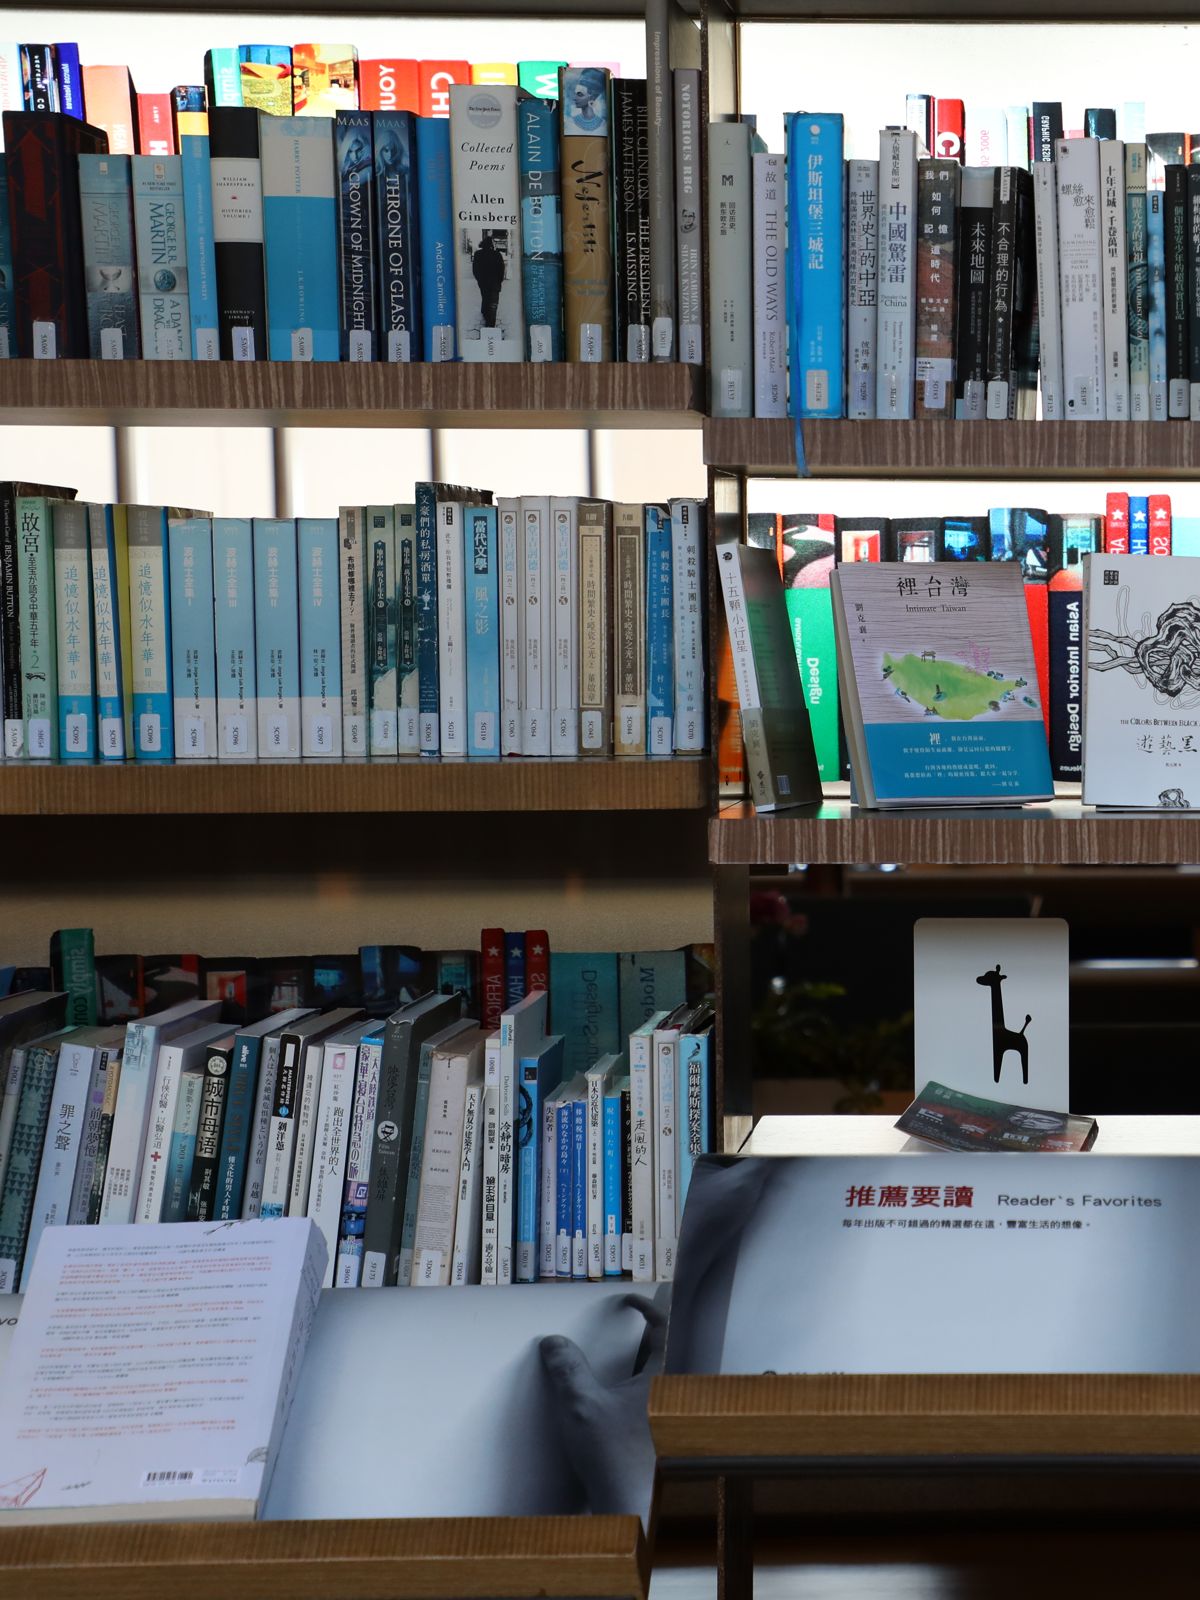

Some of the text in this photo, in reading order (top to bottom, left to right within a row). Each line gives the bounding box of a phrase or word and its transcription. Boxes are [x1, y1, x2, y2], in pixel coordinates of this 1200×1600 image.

[337, 117, 369, 127] MAAS
[376, 119, 406, 129] MAAS
[460, 141, 513, 154] Collected
[622, 91, 635, 212] JAMES PATTERSON
[637, 105, 649, 200] BILL CLINTON
[681, 83, 693, 194] NOTORIOUS RBG
[469, 161, 506, 172] Poems
[526, 113, 544, 261] ALAIN DE BOTTON
[764, 171, 777, 200] 故道
[165, 202, 175, 243] GEORGE
[458, 211, 517, 224] Ginsberg
[470, 194, 505, 204] Allen
[807, 154, 824, 270] 伊斯坦堡三城記
[931, 192, 941, 216] 如何
[149, 202, 167, 265] MARTIN
[349, 172, 365, 330] CROWN OF MIDNIGHT
[386, 174, 404, 332] THRONE OF GLASS
[436, 241, 444, 273] Andrea
[859, 190, 877, 307] 世界史上的中亞
[888, 201, 907, 284] 中國驚雷
[970, 221, 985, 284] 未來地圖
[626, 243, 637, 302] MISSING
[639, 216, 650, 318] THE PRESIDENT
[764, 210, 778, 321] THE OLD WAYS
[993, 223, 1011, 313] 不合理的行為
[884, 298, 907, 308] China
[21, 512, 40, 553] 故宮
[418, 493, 432, 583] 文豪們的私房酒單
[474, 518, 488, 571] 當代文學
[5, 544, 14, 618] BENJAMIN BUTTON
[660, 549, 670, 619] 刺殺騎士團長
[685, 545, 698, 613] 刺殺騎士團長
[896, 575, 970, 599] 裡台灣
[905, 604, 967, 613] Intimate Taiwan
[64, 567, 80, 664] 追憶似水年華
[94, 565, 112, 667] 追憶似水年華
[138, 563, 155, 664] 追憶似水年華
[474, 586, 489, 634] 風之影
[725, 571, 748, 655] 十五顆小行星
[855, 602, 868, 634] 劉克襄
[240, 1044, 249, 1062] alive
[54, 1104, 75, 1151] 罪之聲
[198, 1078, 225, 1156] 城市母语
[590, 1080, 599, 1128] 日本の近代建築
[687, 1062, 701, 1155] 福爾摩斯探案全集
[327, 1106, 343, 1176] 跑出全世界的人
[499, 1120, 512, 1174] 冷靜的暗房
[633, 1119, 648, 1167] 走風的人
[845, 1184, 974, 1209] 推薦要讀
[1082, 1193, 1162, 1208] Favorites
